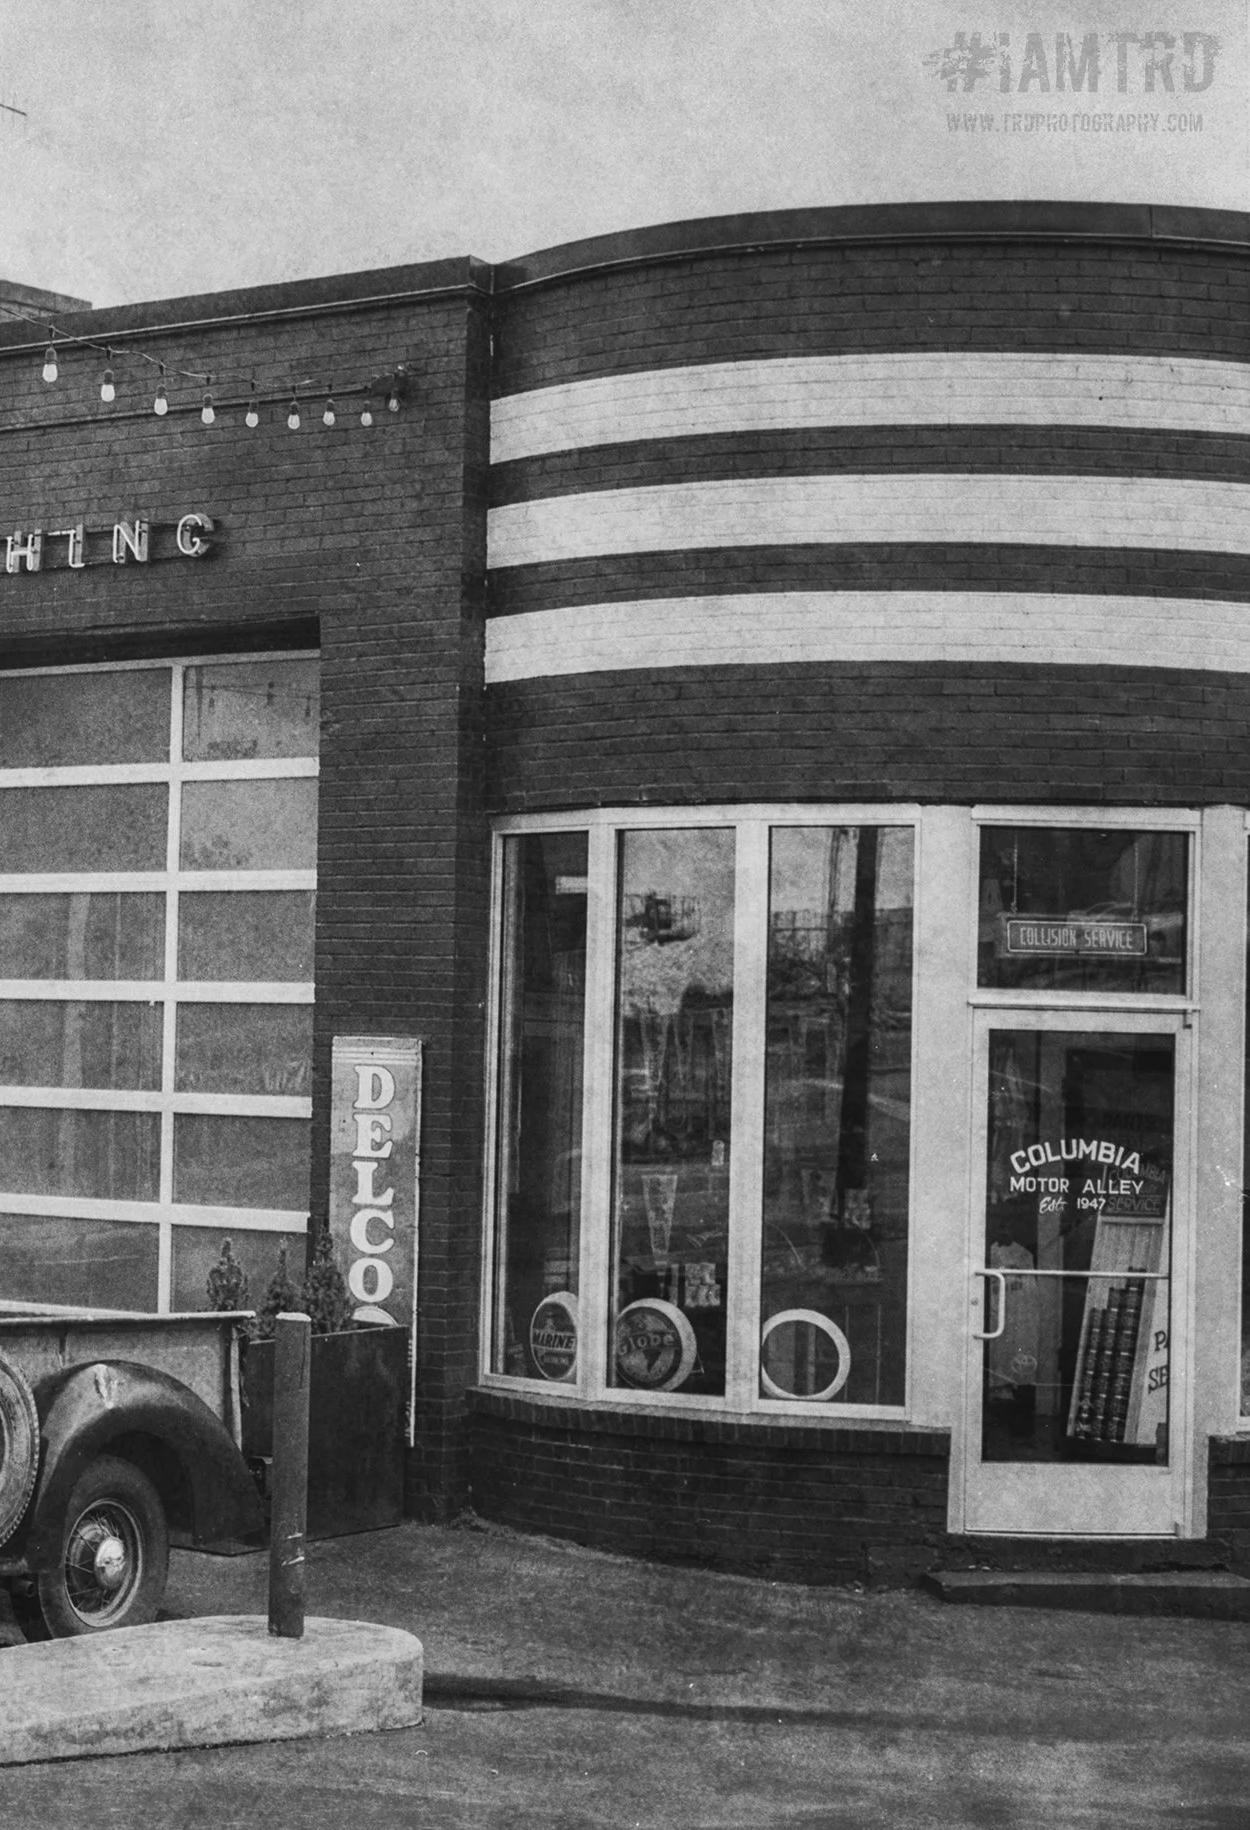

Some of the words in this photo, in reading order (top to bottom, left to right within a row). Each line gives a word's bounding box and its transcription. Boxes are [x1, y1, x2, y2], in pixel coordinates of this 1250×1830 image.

[1019, 926, 1077, 946] COLLISION
[1084, 928, 1134, 949] SERVICE
[1010, 1138, 1140, 1175] COLUMBIA
[348, 1064, 396, 1304] DELCO
[1010, 1176, 1069, 1193] MOTOR
[1082, 1178, 1144, 1195] ALLEY
[1076, 1197, 1106, 1210] 1947
